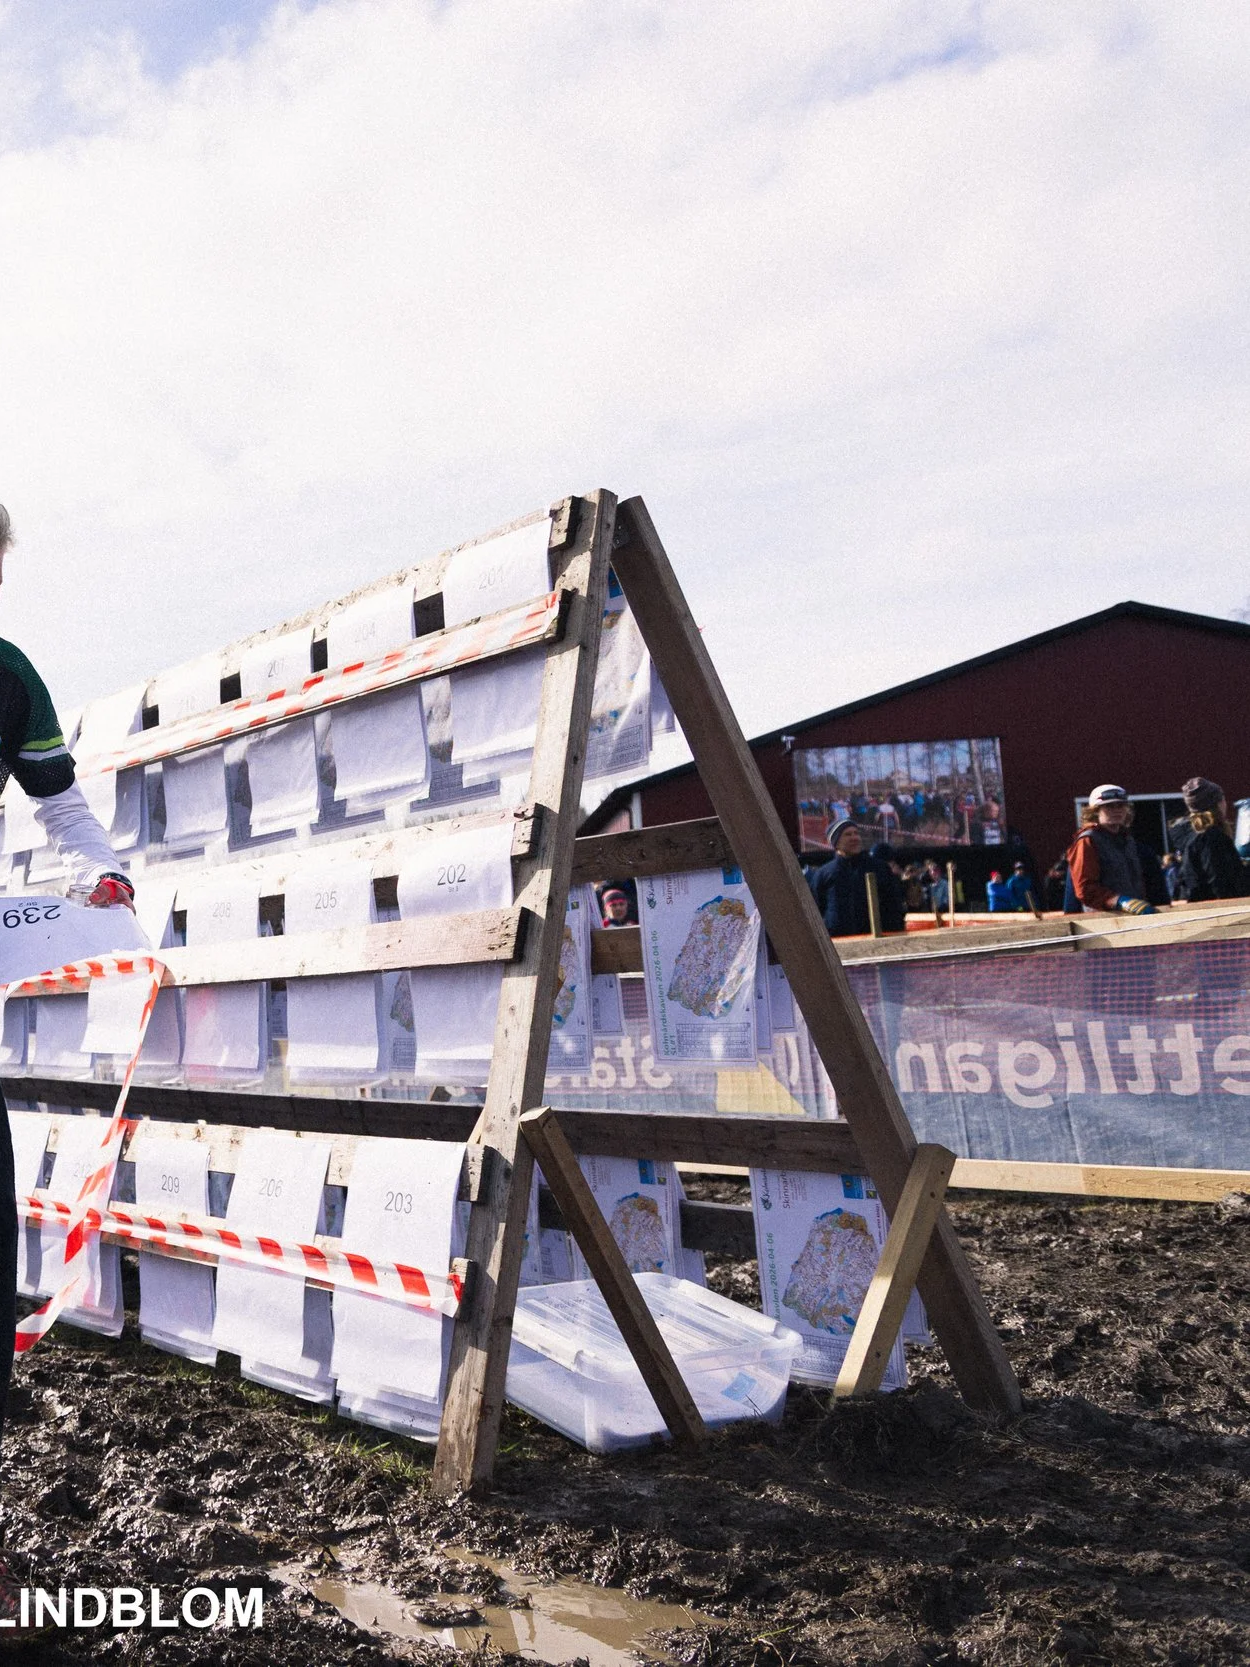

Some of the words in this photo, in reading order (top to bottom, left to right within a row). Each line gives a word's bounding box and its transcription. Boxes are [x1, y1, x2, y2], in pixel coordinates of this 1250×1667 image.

[437, 863, 467, 886] 202
[314, 890, 338, 910] 205
[2, 904, 61, 929] 239
[658, 985, 670, 1056] Kolmårdskavlen
[161, 1174, 180, 1194] 209
[258, 1177, 283, 1198] 206
[384, 1191, 413, 1214] 203
[766, 1231, 777, 1287] 2026-04-06
